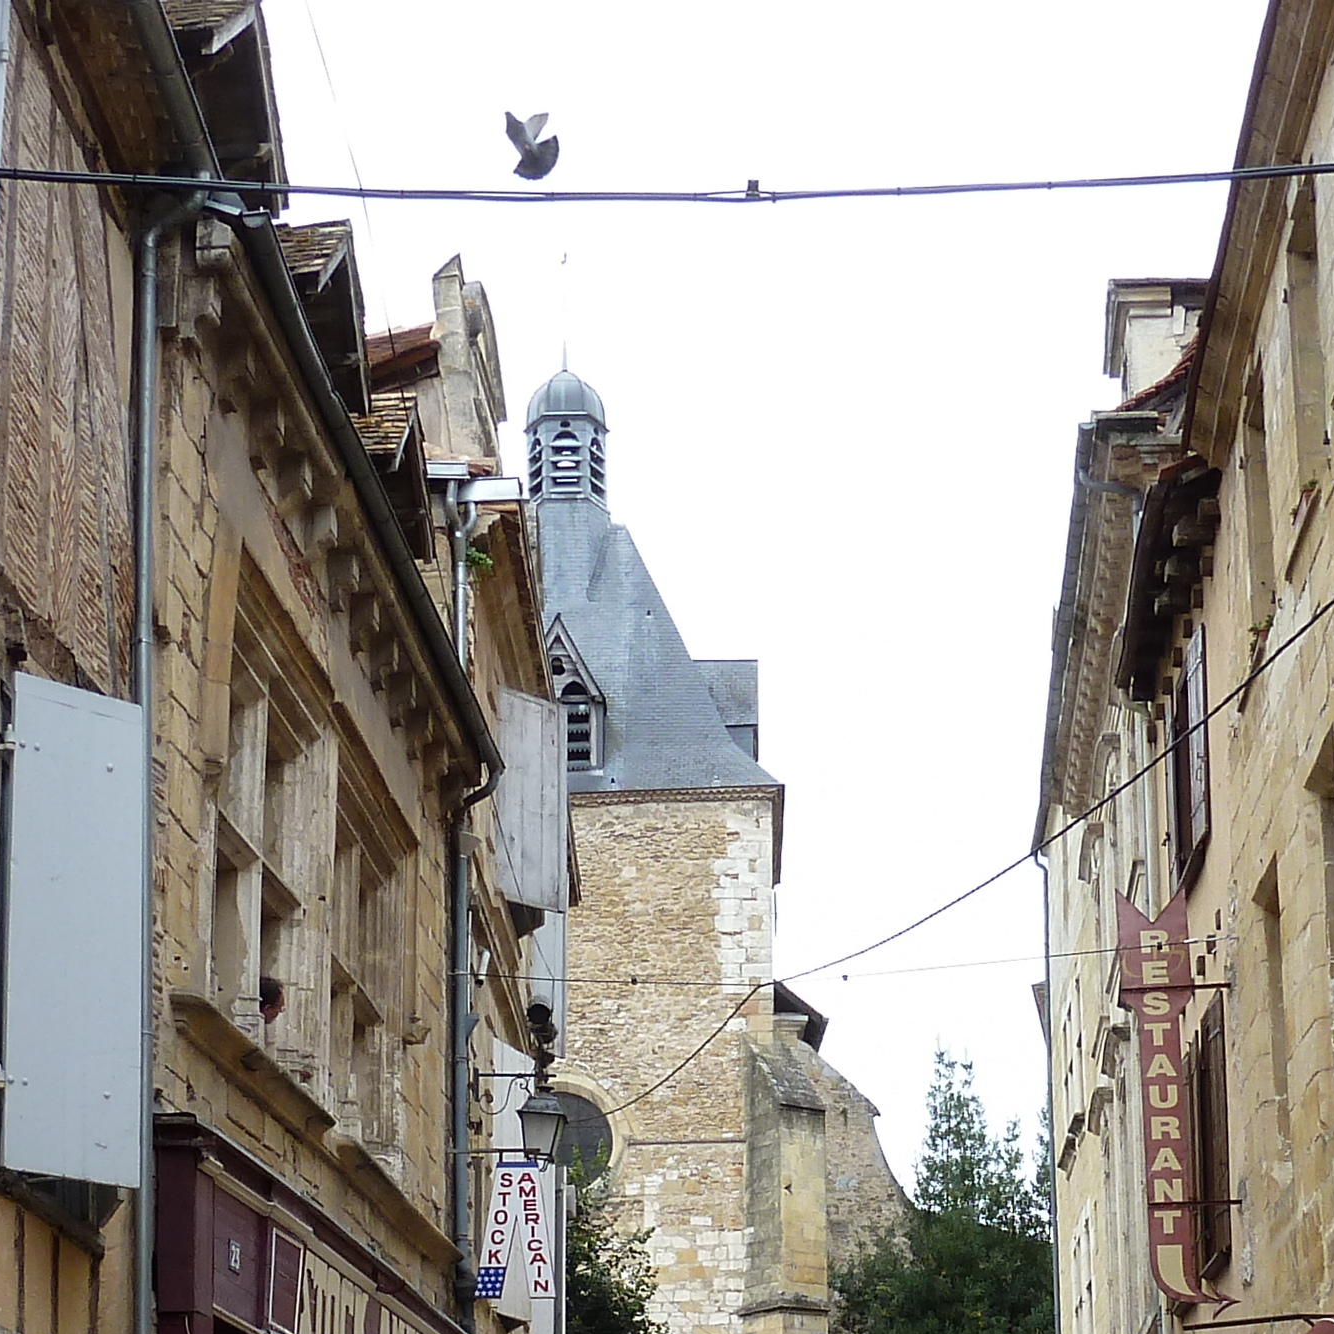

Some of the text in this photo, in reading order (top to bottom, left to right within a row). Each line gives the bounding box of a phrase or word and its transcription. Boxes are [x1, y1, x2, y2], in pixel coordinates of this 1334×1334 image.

[1139, 929, 1183, 1235] RESTAURANT
[487, 1172, 513, 1265] STOCK
[517, 1172, 549, 1293] AMERICAIN
